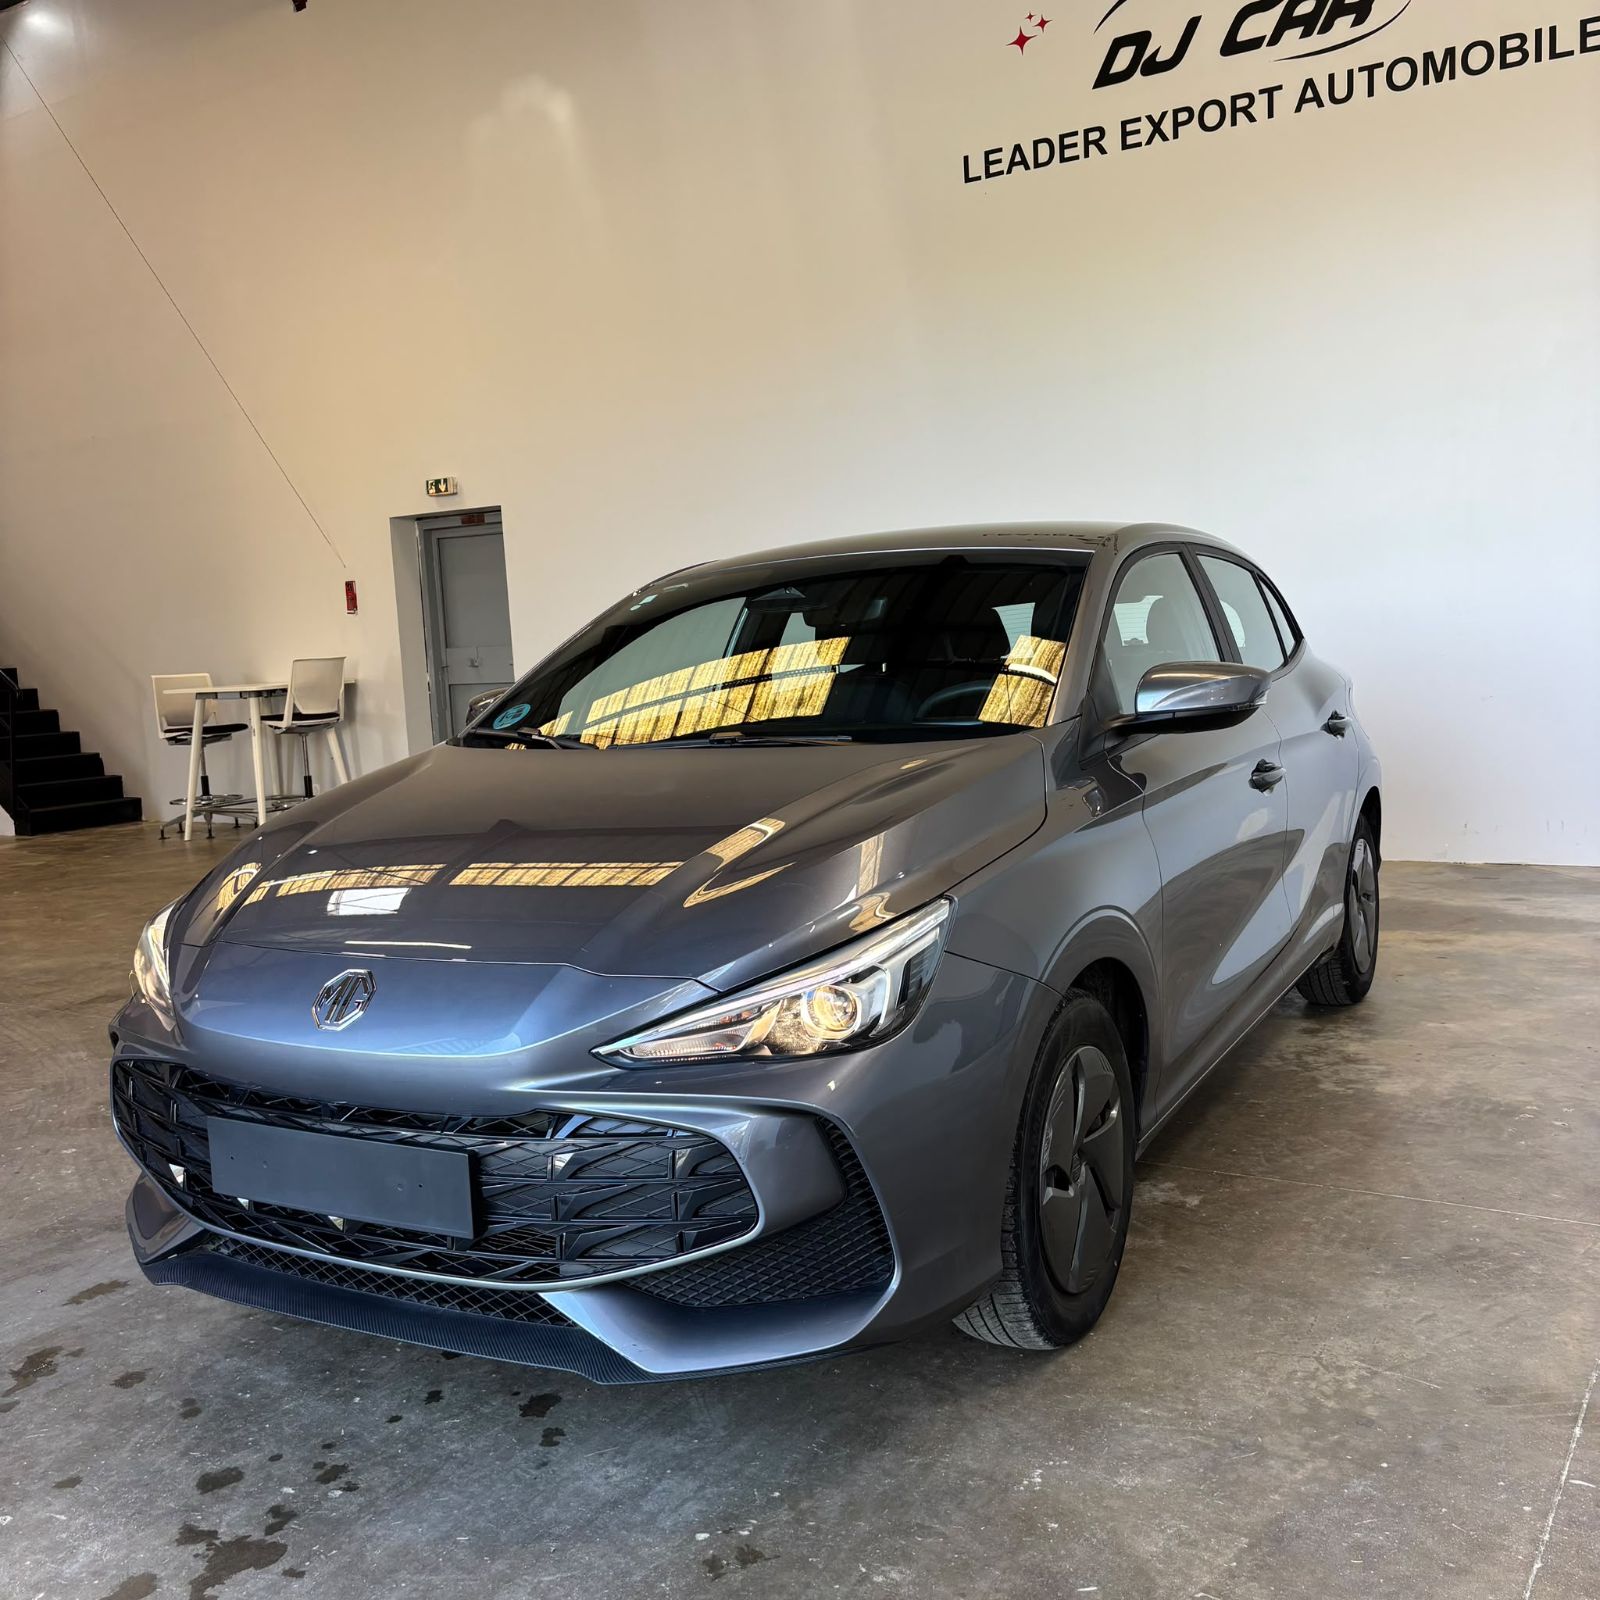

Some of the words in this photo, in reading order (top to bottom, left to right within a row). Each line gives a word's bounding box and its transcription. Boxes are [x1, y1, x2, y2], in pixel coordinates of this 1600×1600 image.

[1091, 16, 1202, 90] DJ
[963, 125, 1108, 184] LEADER
[1120, 84, 1283, 151] EXPORT
[1294, 15, 1600, 114] AUTOMOBILE
[316, 973, 373, 1025] MG
